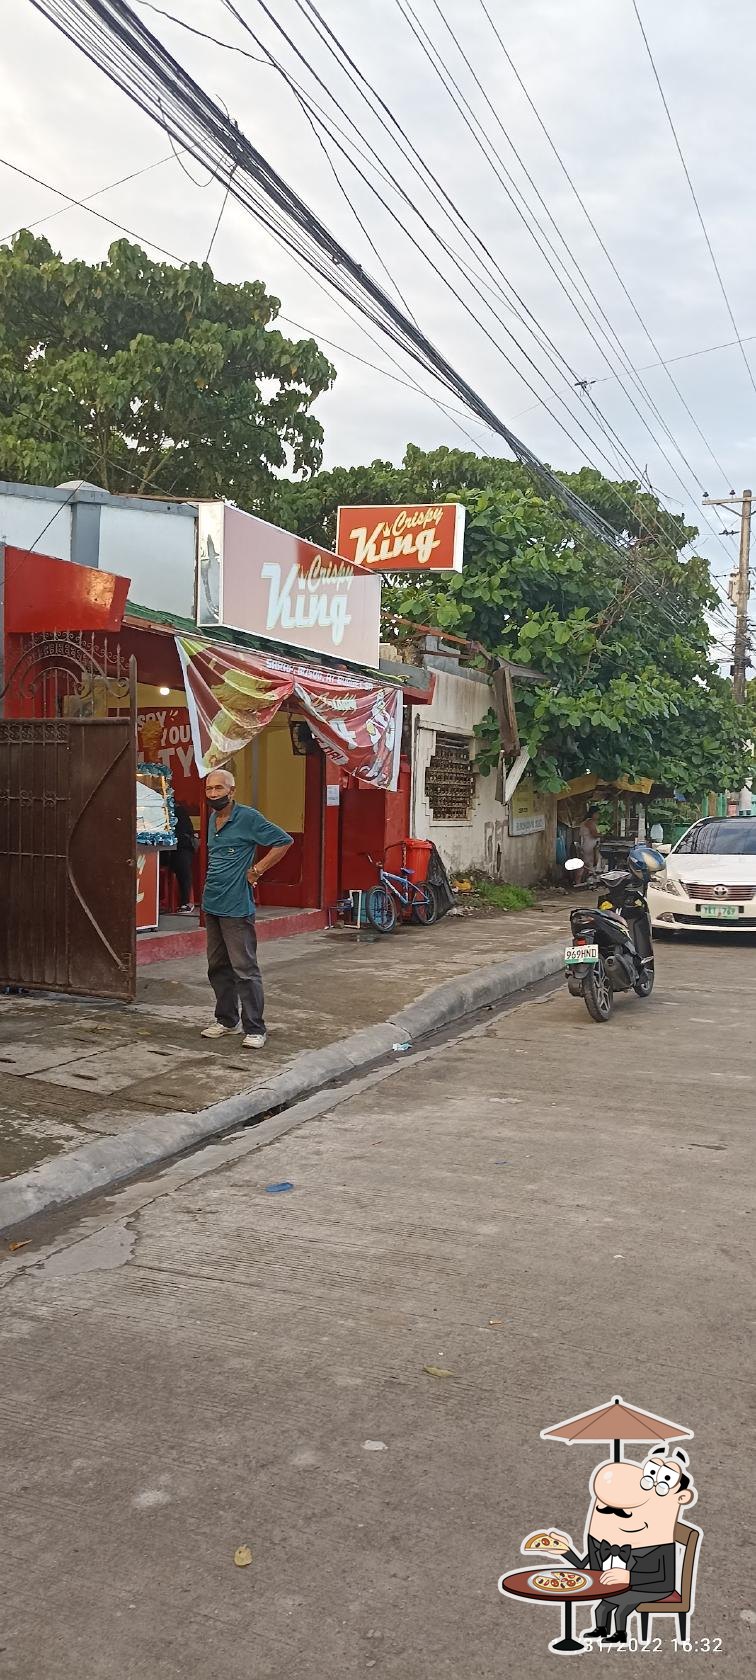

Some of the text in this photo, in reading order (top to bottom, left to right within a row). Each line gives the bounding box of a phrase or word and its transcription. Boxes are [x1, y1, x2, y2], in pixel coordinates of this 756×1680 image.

[392, 507, 444, 537] Crispy
[350, 522, 441, 566] King
[308, 555, 354, 593] Crispy
[260, 562, 352, 646] King
[567, 949, 597, 959] 969HND
